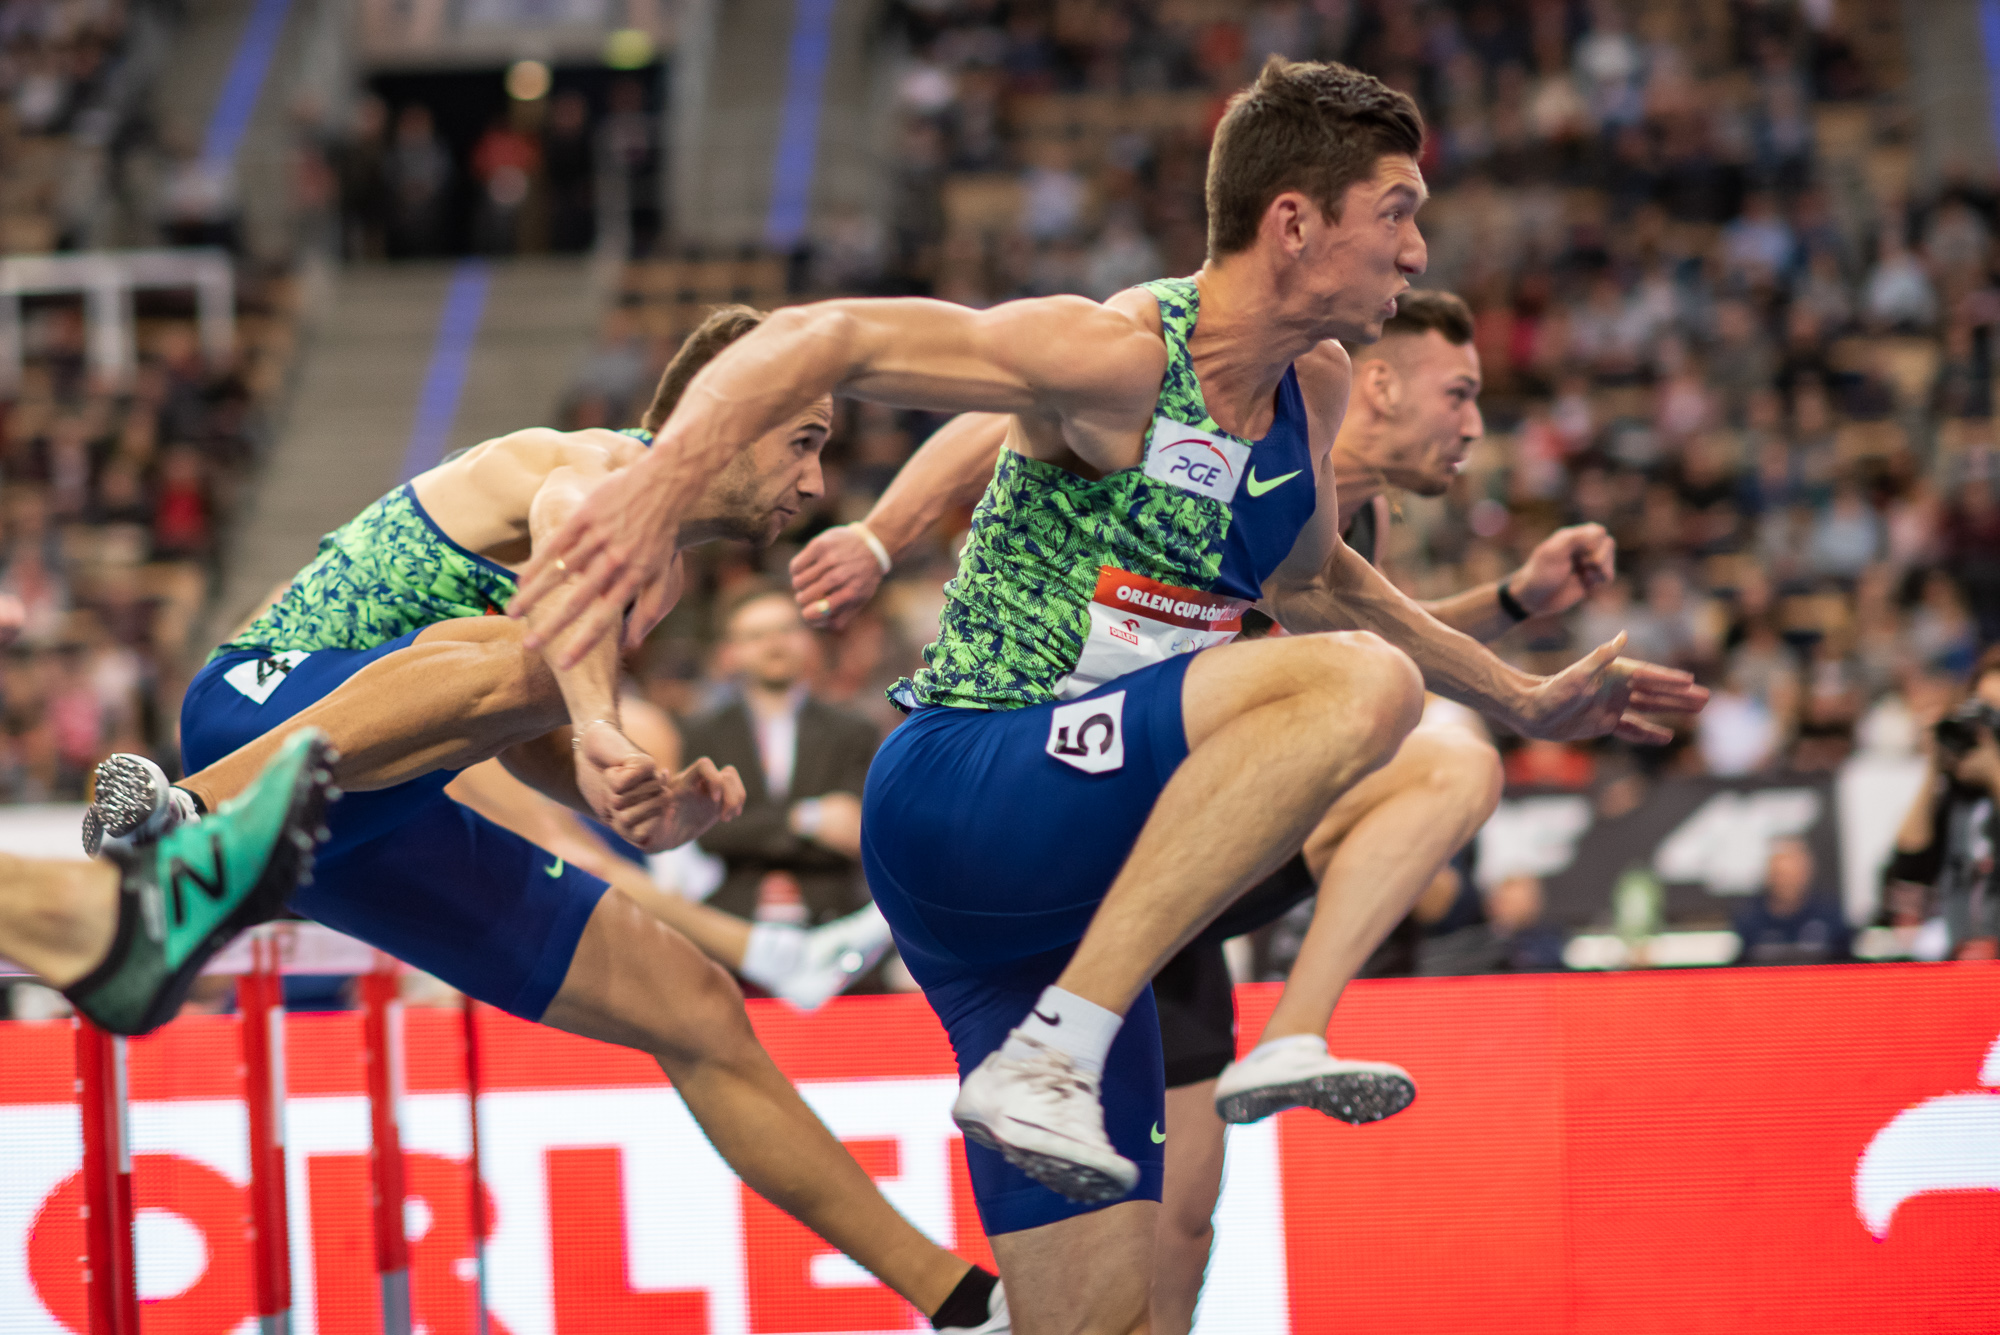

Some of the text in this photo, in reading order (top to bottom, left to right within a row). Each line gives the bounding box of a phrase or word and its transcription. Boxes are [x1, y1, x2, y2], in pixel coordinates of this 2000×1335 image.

[1169, 455, 1222, 487] PGE
[1116, 585, 1175, 613] ORLEN
[1173, 601, 1200, 618] CUP
[1111, 627, 1137, 644] ORLEN
[257, 658, 292, 687] 4
[1054, 713, 1114, 756] 5
[27, 1136, 1000, 1335] ORLE
